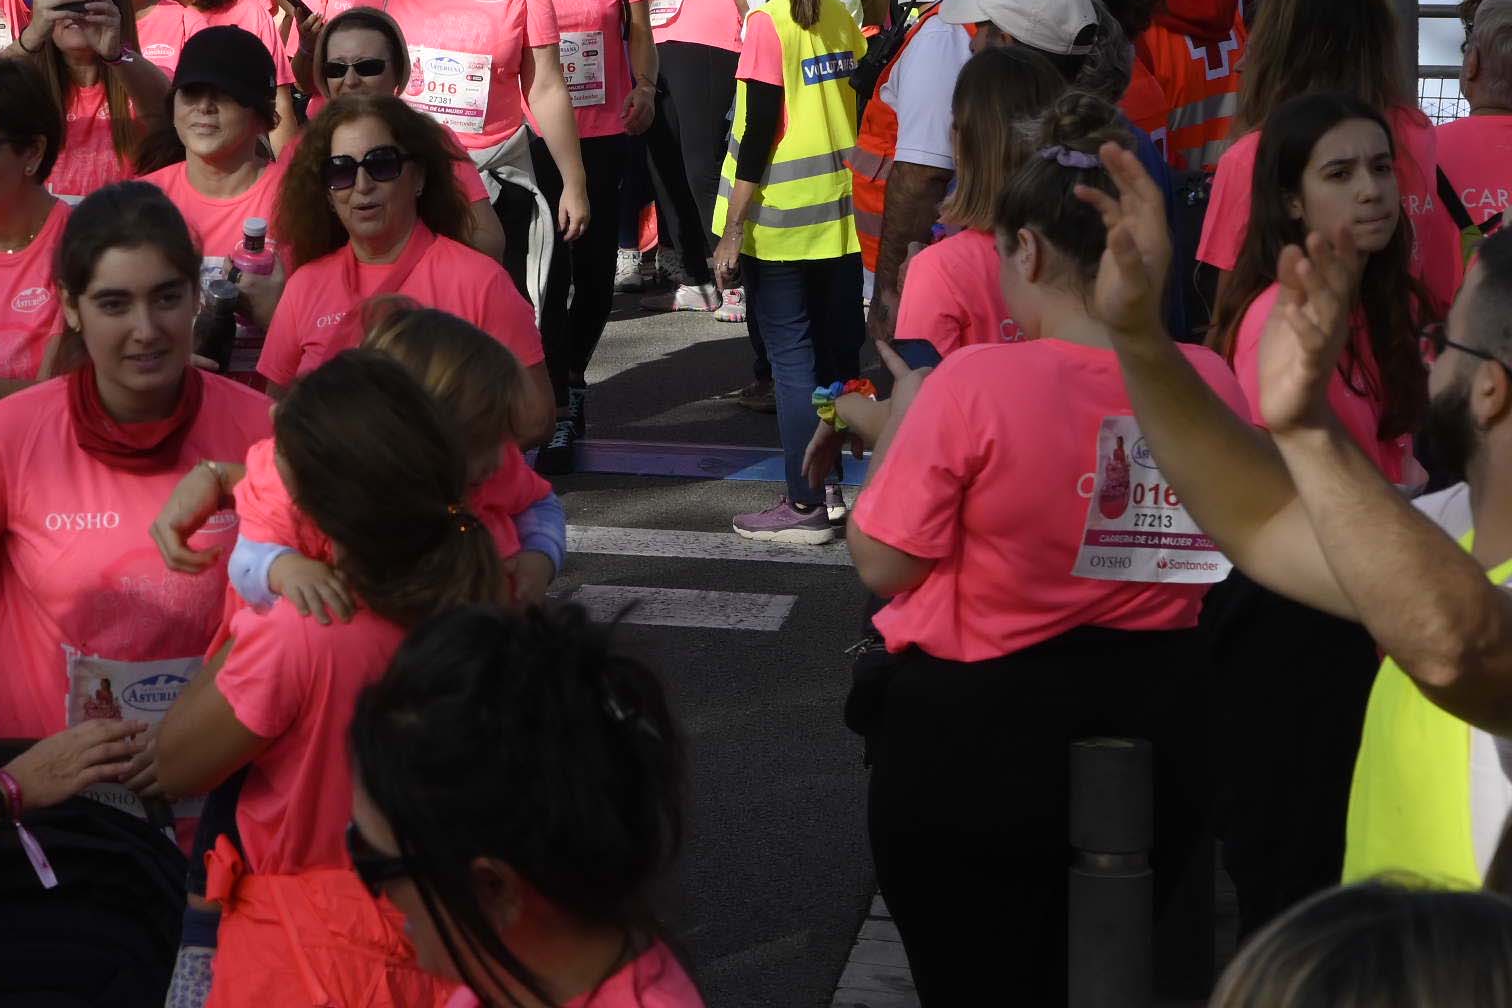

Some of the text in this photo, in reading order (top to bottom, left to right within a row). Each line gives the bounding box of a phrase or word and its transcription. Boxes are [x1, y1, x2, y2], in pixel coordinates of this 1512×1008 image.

[427, 80, 457, 94] 016
[428, 95, 452, 105] 27381
[317, 311, 346, 329] OYS
[1133, 483, 1180, 506] 016
[46, 511, 120, 530] OYSHO
[1134, 513, 1173, 529] 27213
[1135, 535, 1147, 544] DE
[1148, 535, 1160, 545] LA
[1160, 536, 1193, 546] MUJER
[1090, 556, 1132, 569] OYSHO
[1169, 560, 1219, 571] Santander
